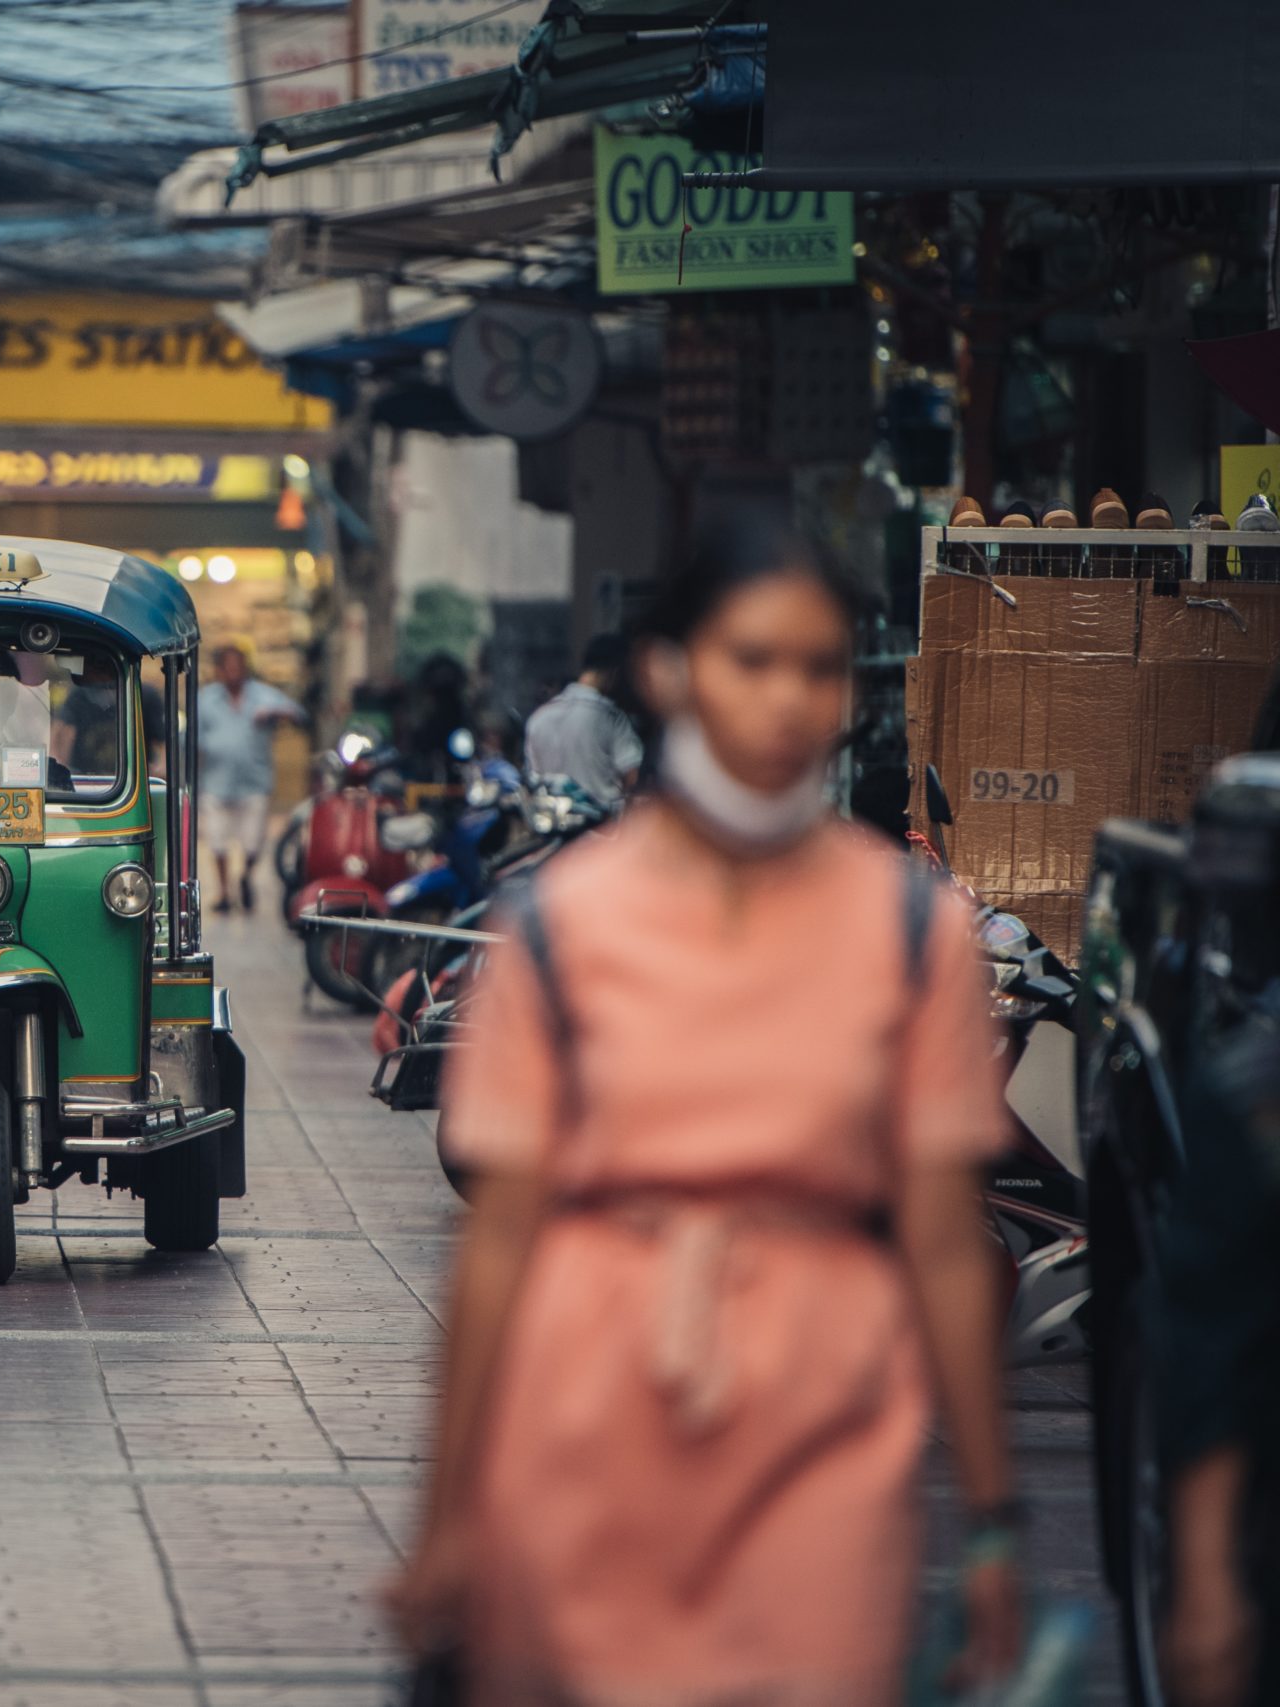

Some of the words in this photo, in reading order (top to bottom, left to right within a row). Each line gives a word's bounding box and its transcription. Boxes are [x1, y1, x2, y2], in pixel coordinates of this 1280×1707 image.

[616, 235, 736, 266] FASHION
[746, 230, 838, 262] SHOES
[74, 320, 264, 370] STATIO
[973, 771, 1059, 800] 99-20
[995, 1178, 1043, 1187] HONDA
